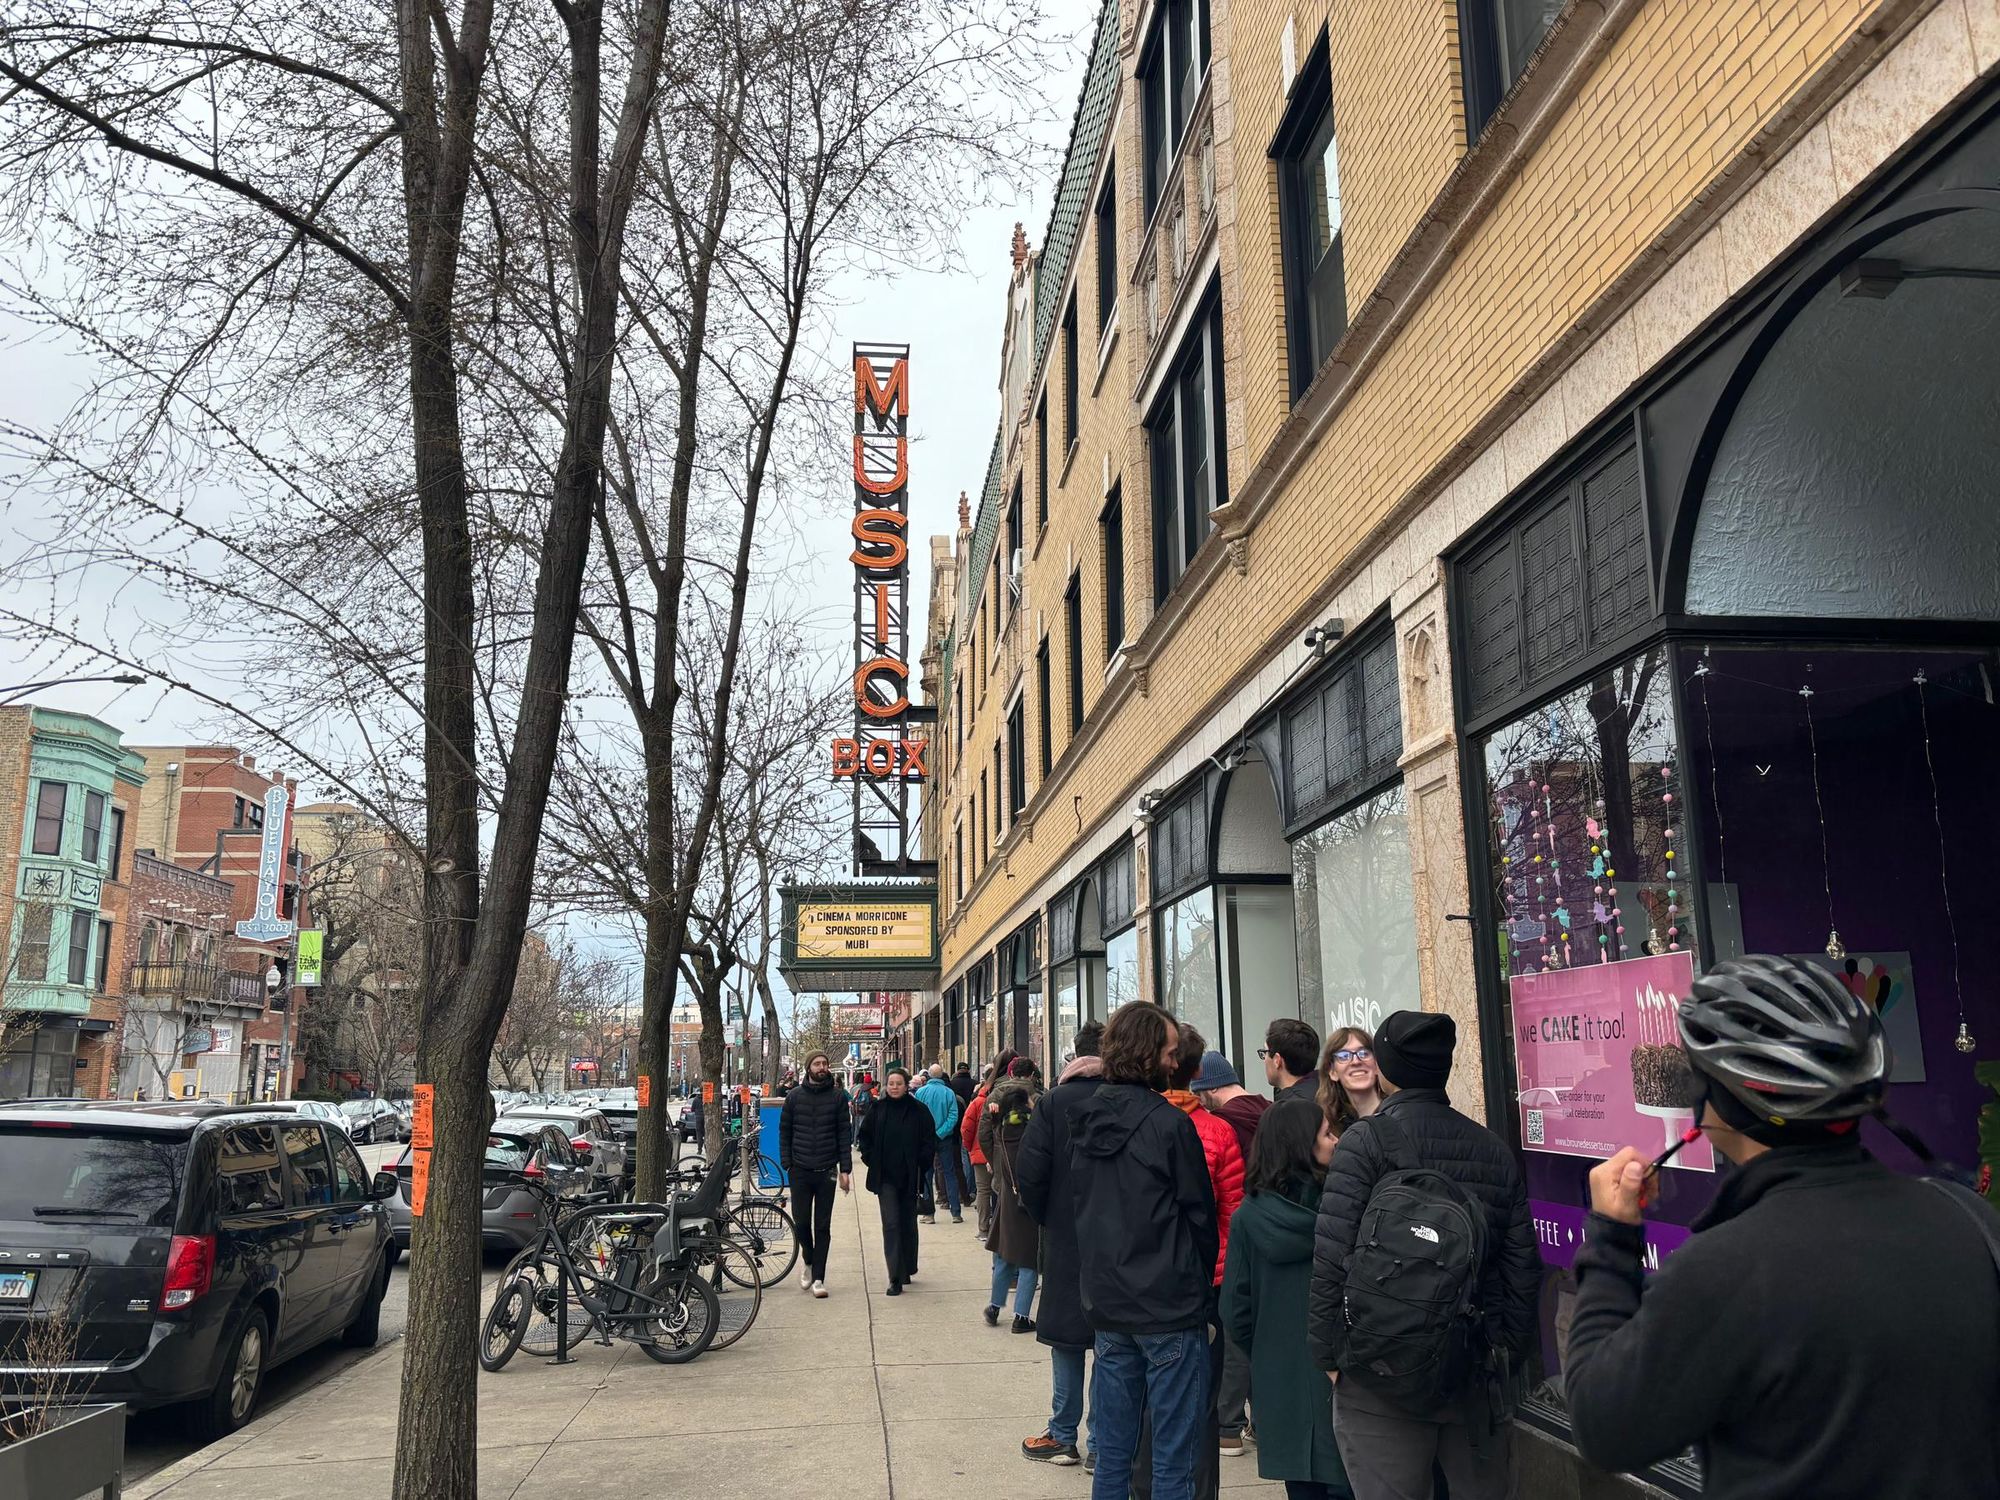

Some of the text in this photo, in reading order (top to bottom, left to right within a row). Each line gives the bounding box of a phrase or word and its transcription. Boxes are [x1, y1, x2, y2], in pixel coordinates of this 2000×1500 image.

[850, 357, 911, 717] MUSIC
[832, 738, 929, 776] BOX
[268, 789, 282, 845] BLUE
[259, 850, 277, 920] BAYOU
[816, 911, 908, 922] CINEMA MORRICONE
[825, 925, 894, 935] SPONSORED BY
[845, 940, 869, 949] MUBI
[1330, 996, 1382, 1036] MUSIC
[1519, 1011, 1626, 1043] we CAKE it too!
[1574, 1107, 1605, 1119] celebration
[1592, 1093, 1605, 1105] your
